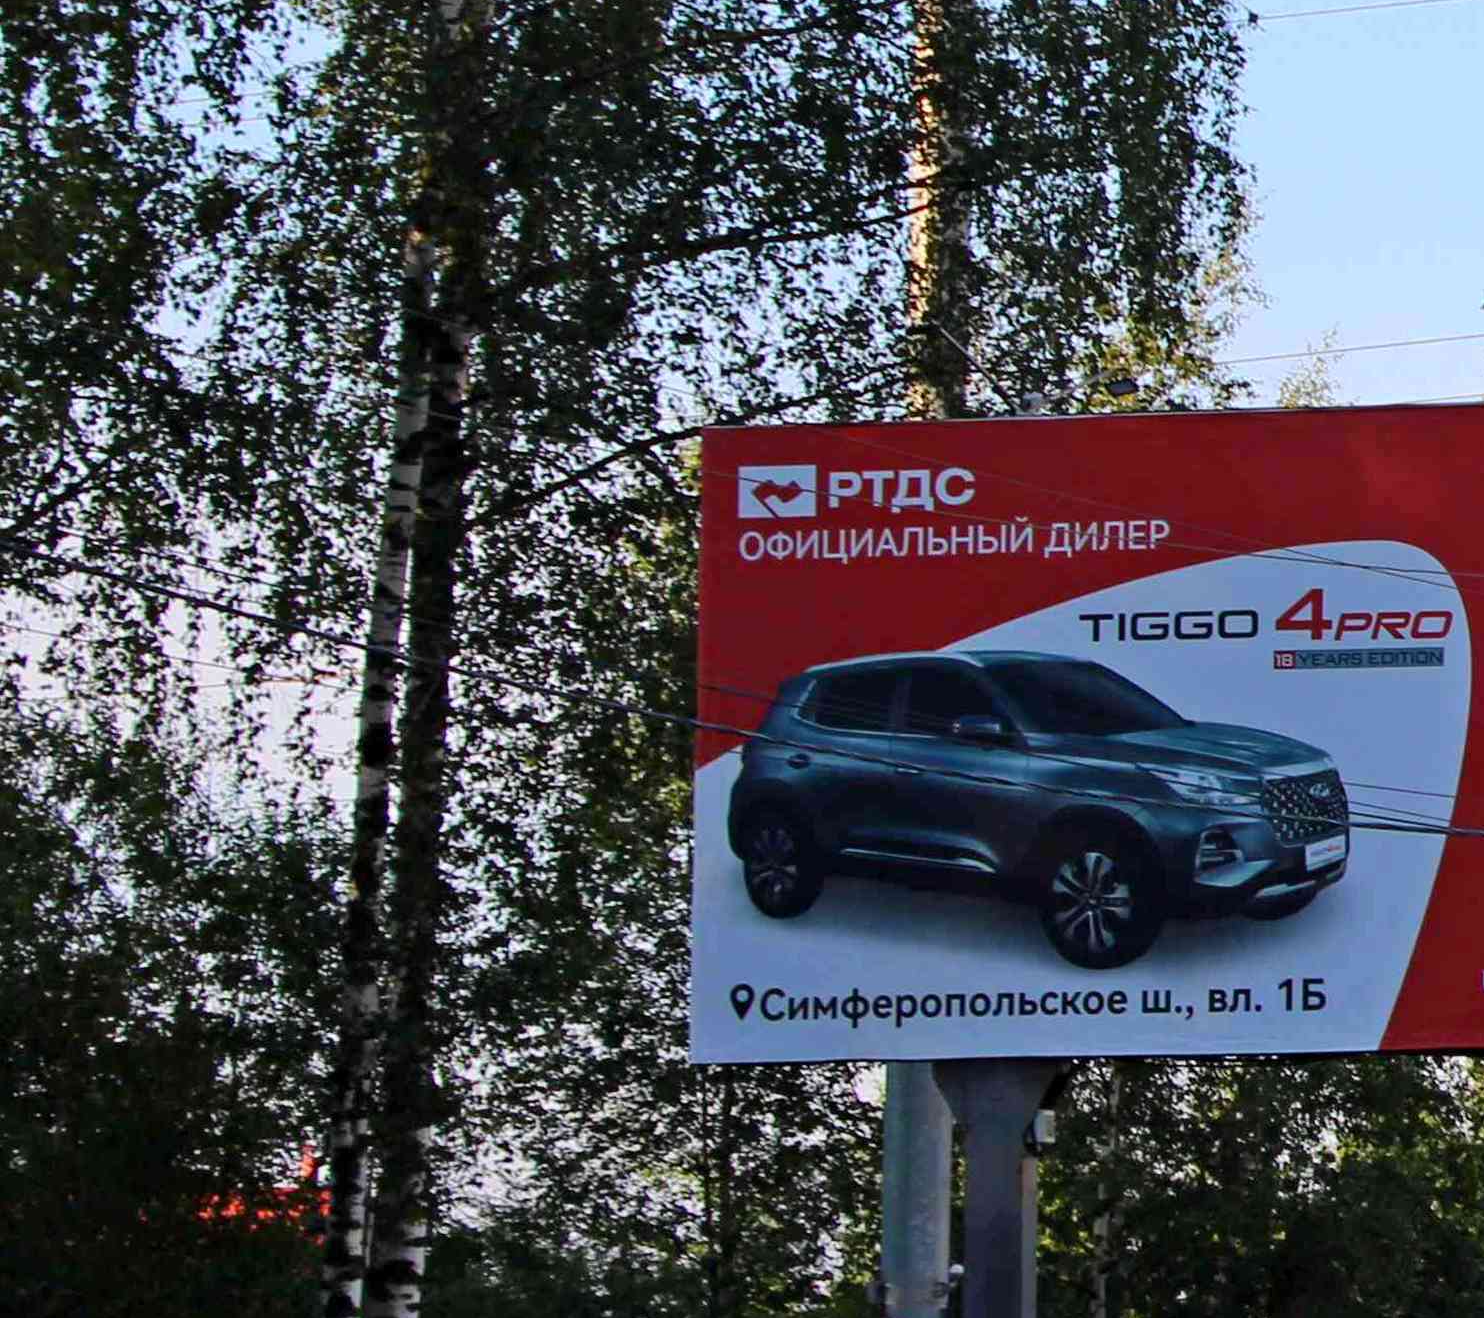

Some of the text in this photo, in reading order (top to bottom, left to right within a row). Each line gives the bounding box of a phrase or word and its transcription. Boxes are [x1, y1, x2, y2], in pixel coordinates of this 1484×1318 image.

[826, 467, 977, 513] РТДС
[738, 515, 1171, 565] ОФИЦИАЛЬНЫЙ ДИЛЕР
[1078, 609, 1260, 642] TIGGO
[1274, 649, 1444, 669] 18 YEARS EDITION
[758, 978, 1328, 1028] Симферопольское ш., вл. 1Б
